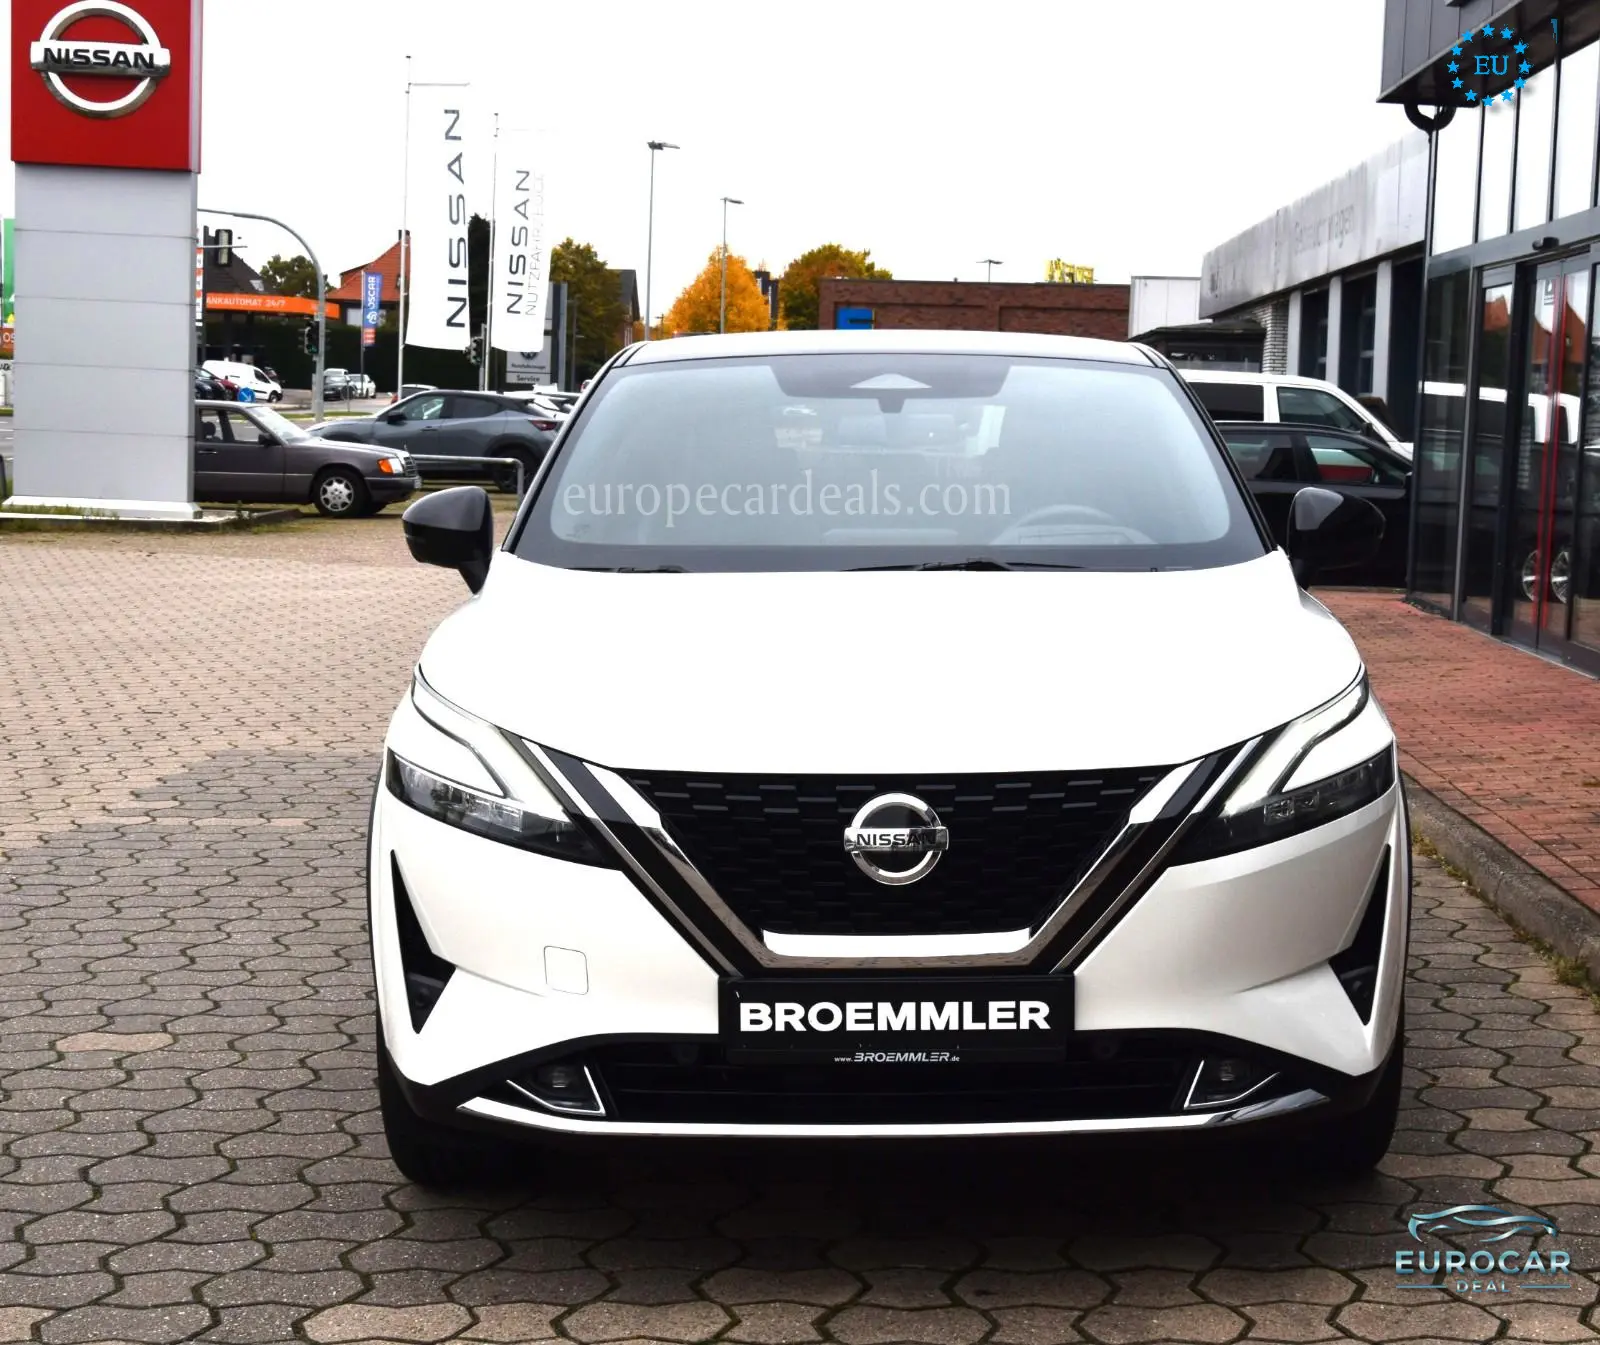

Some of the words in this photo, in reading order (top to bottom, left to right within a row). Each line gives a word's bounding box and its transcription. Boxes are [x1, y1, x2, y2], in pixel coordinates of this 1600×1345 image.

[43, 47, 154, 69] NISSAN
[444, 109, 467, 328] NISSAN
[506, 170, 530, 315] NISSAN
[367, 275, 376, 310] OSCAR
[856, 832, 937, 846] NISSAN
[740, 1001, 1051, 1032] BROEMMLER
[834, 1052, 960, 1063] www.BROEMMLER.de
